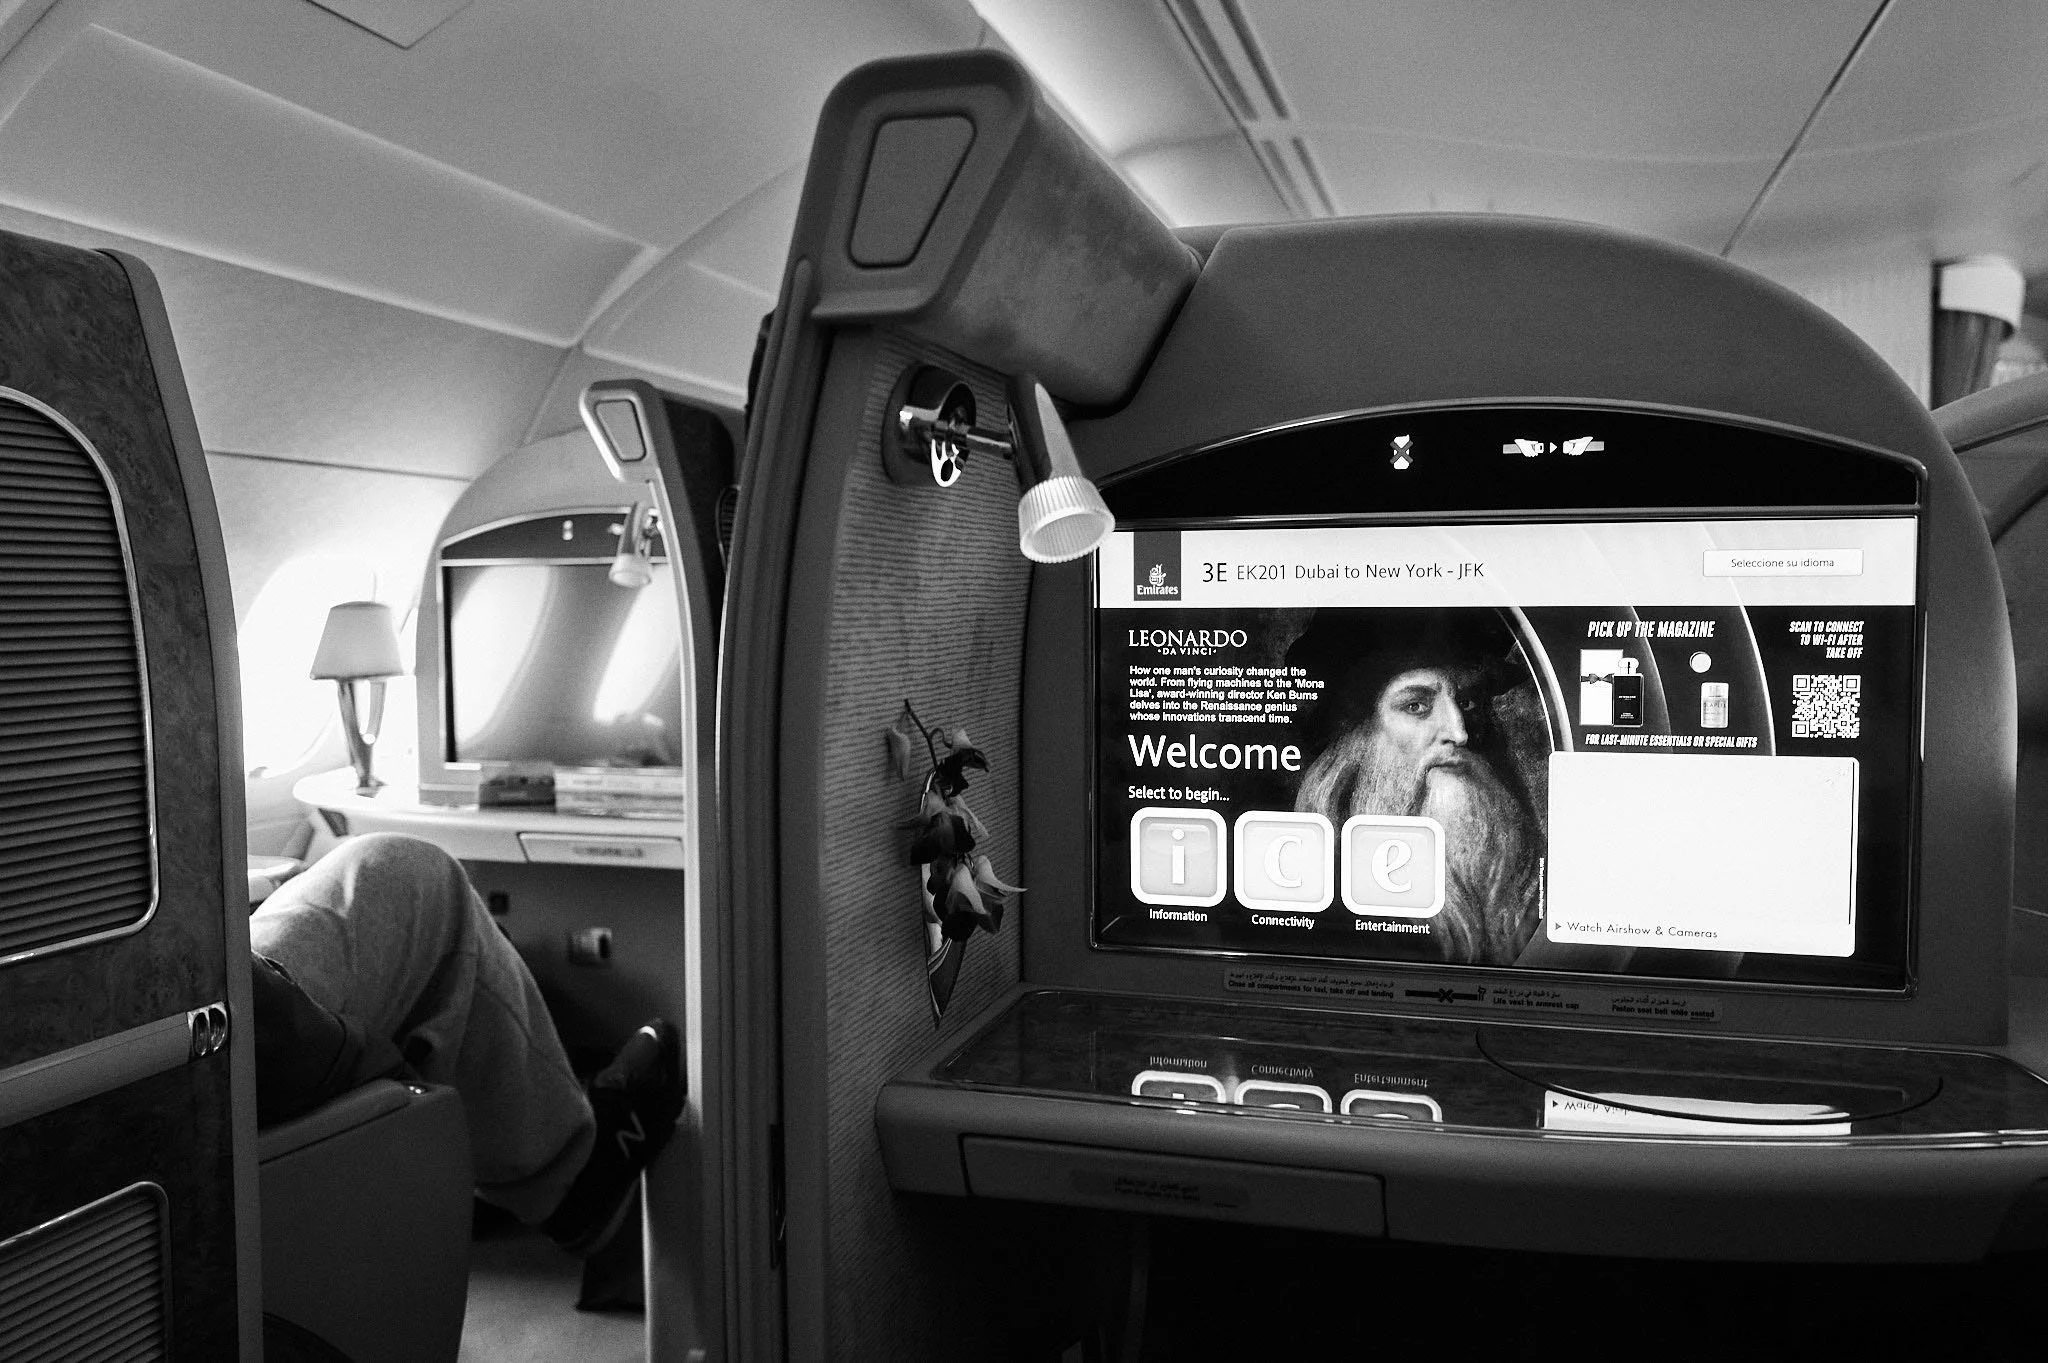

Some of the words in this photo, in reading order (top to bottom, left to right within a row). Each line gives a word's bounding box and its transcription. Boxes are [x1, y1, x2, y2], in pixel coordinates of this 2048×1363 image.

[1731, 559, 1784, 567] Seleccione
[1801, 559, 1834, 567] idioma
[1202, 562, 1227, 583] 3E
[1237, 565, 1286, 580] EK201
[1295, 563, 1340, 580] Dubai
[1344, 565, 1361, 579] to
[1366, 564, 1400, 579] New
[1406, 563, 1442, 578] York
[1457, 563, 1484, 579] JFK
[1137, 585, 1178, 595] Emirates
[1588, 621, 1613, 638] PICK
[1616, 621, 1632, 637] UP
[1635, 621, 1655, 638] THE
[1657, 621, 1715, 638] MAGAZINE
[1789, 621, 1812, 632] SCAN
[1813, 621, 1824, 632] TO
[1825, 621, 1864, 632] CONNECT
[1129, 629, 1248, 648] LEONARDO
[1800, 634, 1811, 645] TO
[1812, 634, 1836, 645] WI-FI
[1837, 634, 1863, 645] AFTER
[1826, 647, 1846, 658] TAKE
[1847, 647, 1863, 658] OFF
[1129, 665, 1150, 675] How
[1153, 667, 1171, 675] one
[1173, 666, 1201, 675] man's
[1204, 666, 1244, 677] curiosity
[1246, 667, 1287, 677] changed
[1290, 667, 1306, 676] the
[1129, 677, 1157, 687] world.
[1161, 678, 1185, 687] From
[1187, 678, 1213, 689] flying
[1216, 679, 1261, 688] machines
[1264, 679, 1273, 687] to
[1276, 679, 1292, 688] the
[1294, 679, 1325, 688] 'Mona
[1129, 689, 1155, 699] Lisa',
[1157, 690, 1225, 700] award-winning
[1227, 690, 1264, 699] director
[1266, 690, 1286, 699] Ken
[1288, 690, 1318, 700] Burns
[1129, 700, 1160, 710] delves
[1163, 701, 1181, 710] into
[1183, 701, 1198, 710] the
[1200, 701, 1262, 711] Renaissance
[1264, 702, 1297, 713] genius
[1129, 712, 1160, 721] whose
[1163, 712, 1216, 722] innovations
[1218, 713, 1266, 722] transcend
[1268, 714, 1292, 723] time.
[1585, 734, 1600, 745] FOR
[1601, 734, 1649, 746] LAST-MINUTE
[1650, 735, 1692, 747] ESSENTIALS
[1693, 736, 1704, 747] OR
[1705, 736, 1735, 747] SPECIAL
[1736, 737, 1758, 748] GIFTS
[1127, 734, 1301, 772] Welcome
[1128, 785, 1166, 800] Select
[1168, 787, 1183, 800] to
[1185, 787, 1230, 803] begin...
[1149, 908, 1208, 922] Information
[1251, 914, 1315, 930] Connectivity
[1355, 919, 1431, 934] Entertainment
[1567, 922, 1602, 933] Watch
[1607, 923, 1651, 935] Airshow
[1656, 926, 1663, 936] &
[1668, 926, 1718, 938] Cameras
[1257, 983, 1301, 992] compartments
[1612, 1004, 1635, 1012] Fasten
